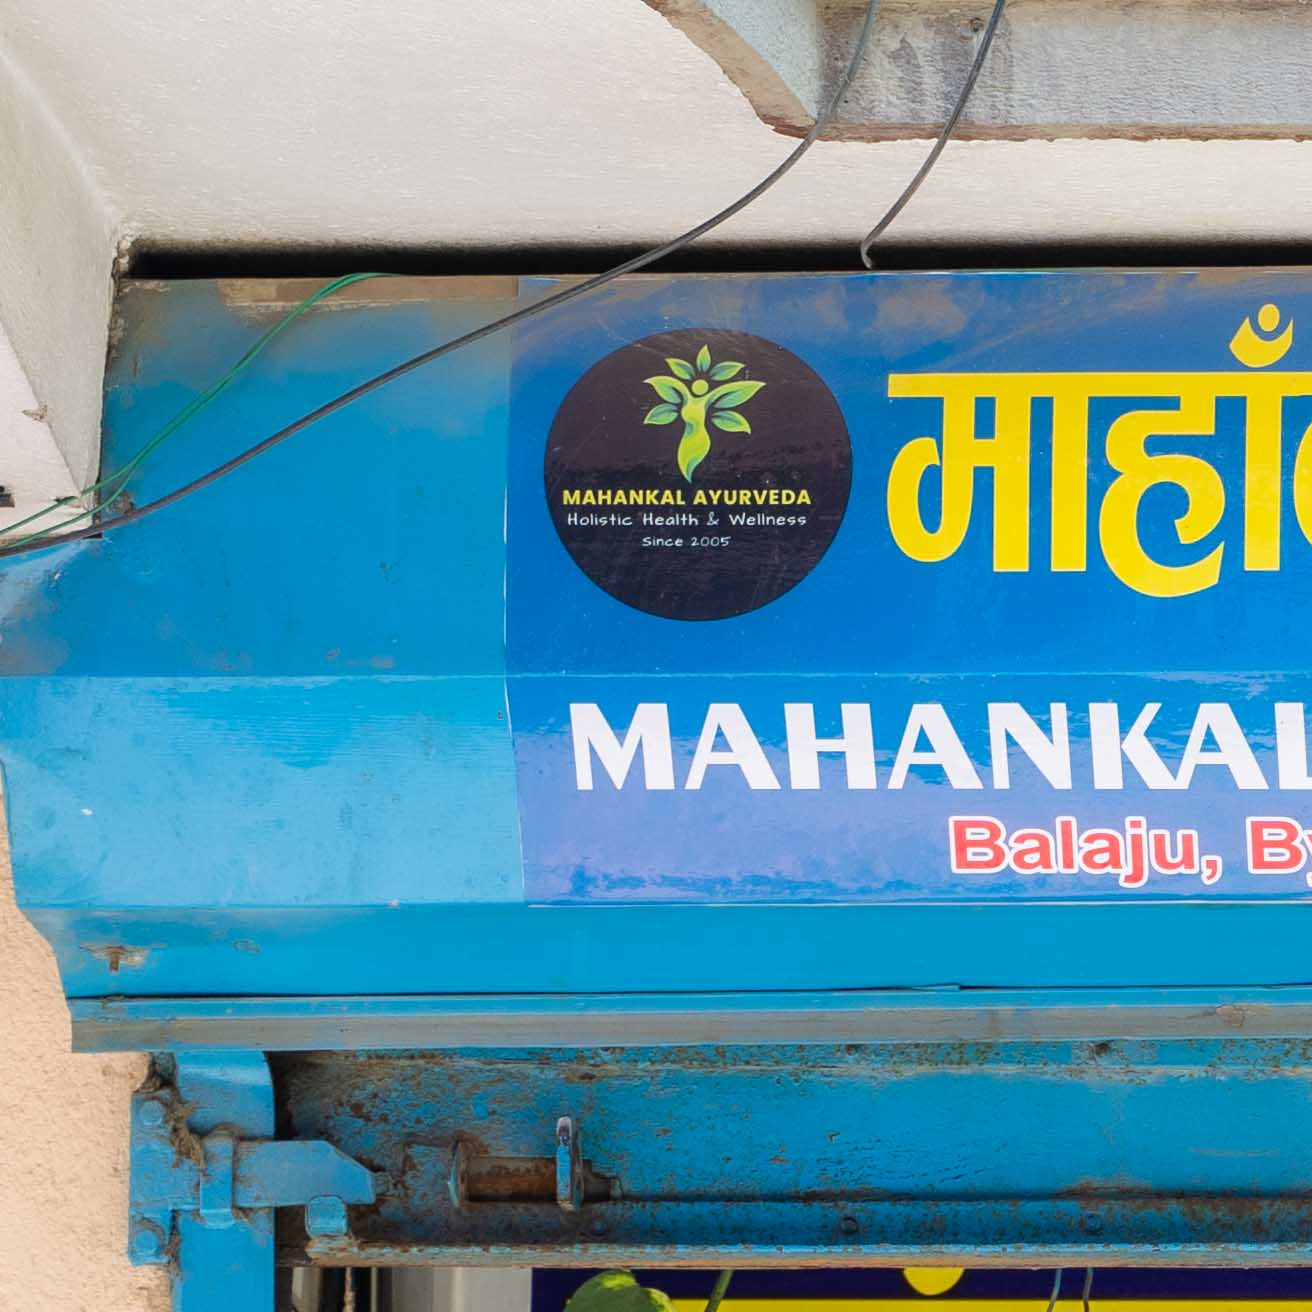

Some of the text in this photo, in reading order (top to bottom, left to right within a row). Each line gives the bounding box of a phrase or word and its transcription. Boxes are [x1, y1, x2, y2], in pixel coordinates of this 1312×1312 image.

[562, 489, 812, 505] MAHANKAL AYURVEDA
[567, 511, 808, 527] Holistic Health & Wellness
[642, 536, 732, 547] Since 2005
[949, 815, 1223, 888] Balaju,
